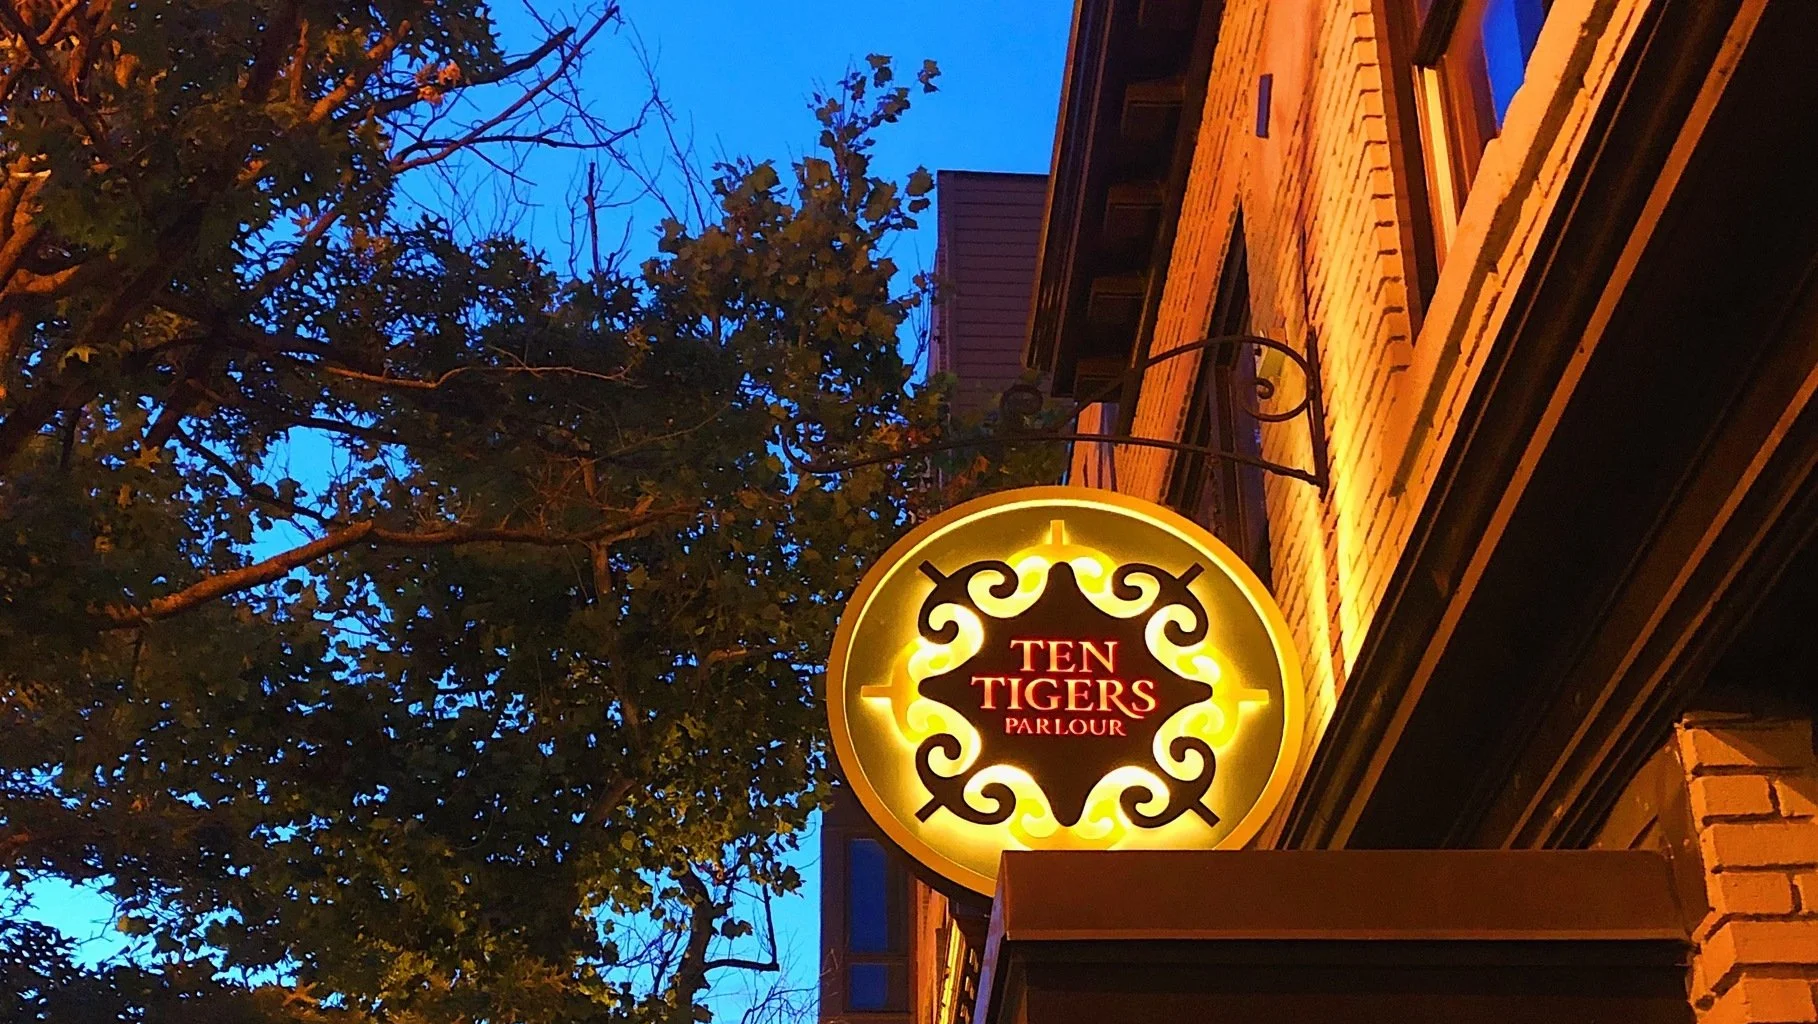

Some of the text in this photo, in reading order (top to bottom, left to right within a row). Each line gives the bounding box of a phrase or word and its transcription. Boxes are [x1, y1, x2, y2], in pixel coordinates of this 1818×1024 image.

[1009, 639, 1118, 674] TEN
[970, 676, 1156, 719] TIGERS
[1004, 717, 1127, 737] PARLOUR
